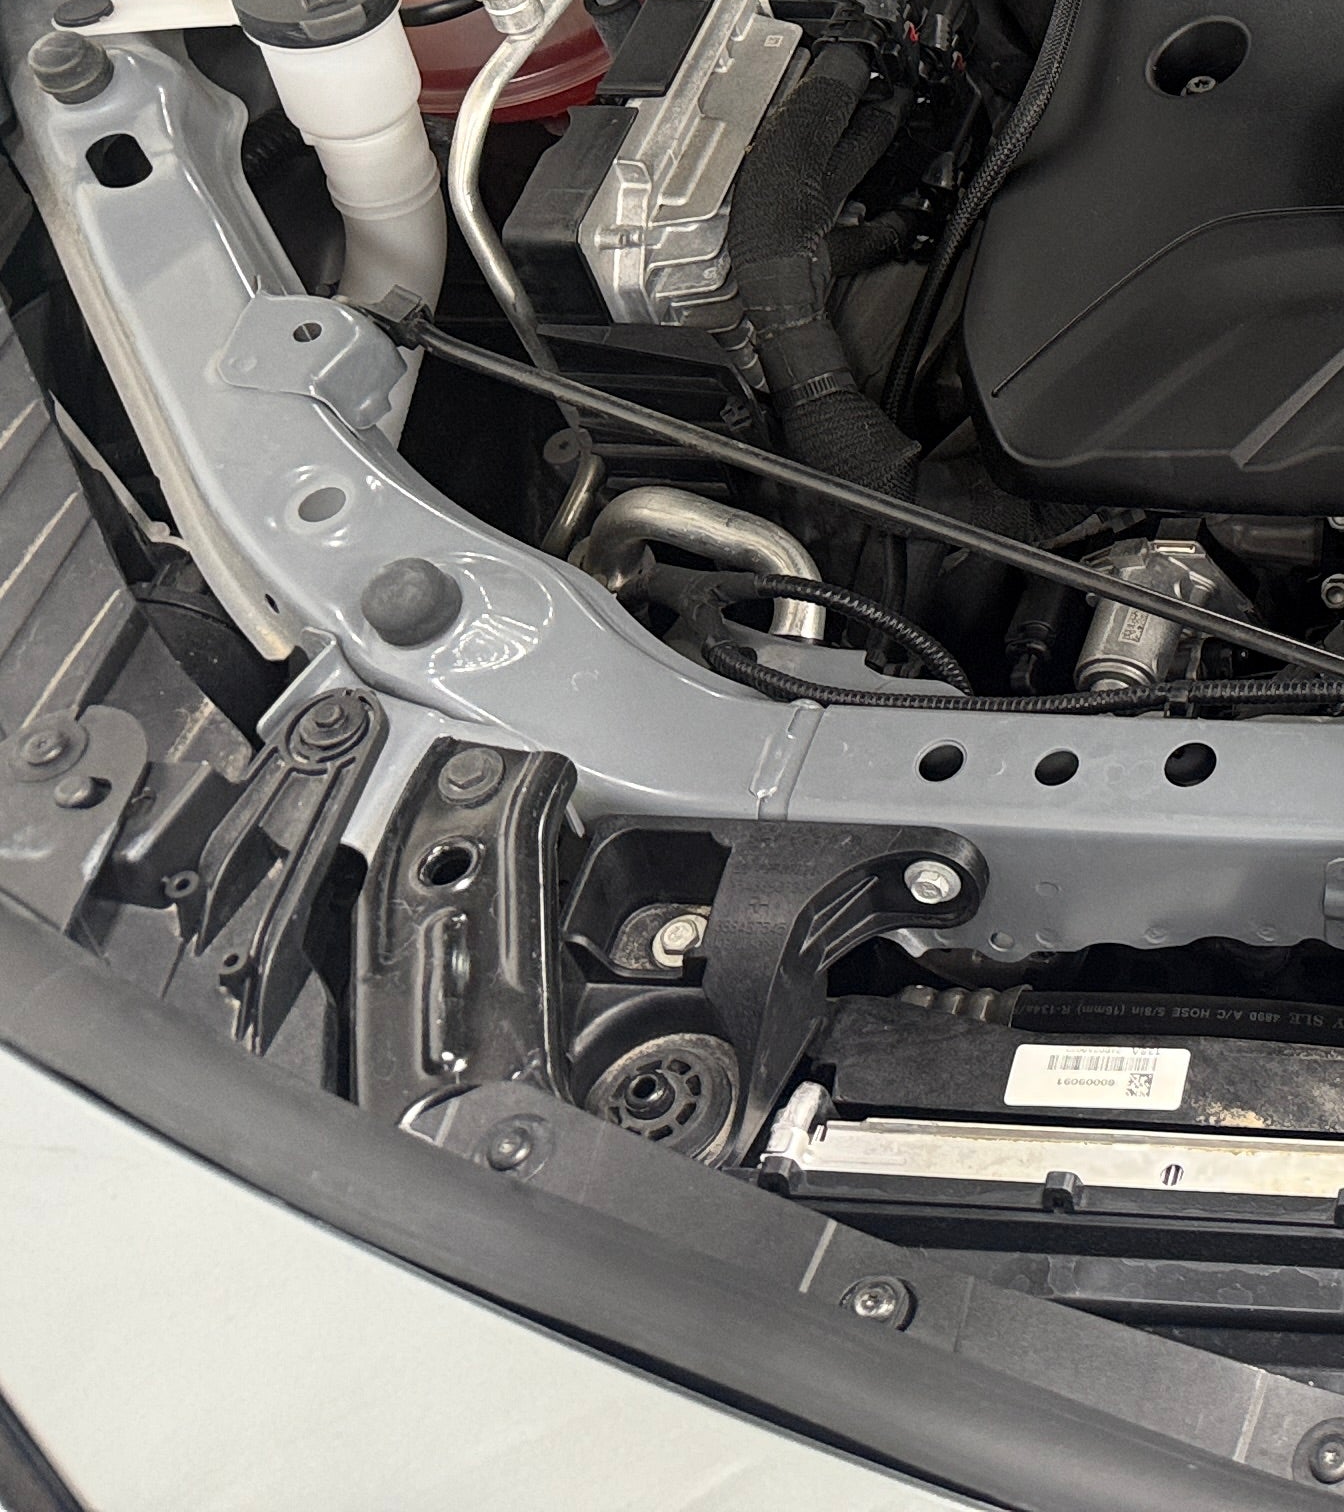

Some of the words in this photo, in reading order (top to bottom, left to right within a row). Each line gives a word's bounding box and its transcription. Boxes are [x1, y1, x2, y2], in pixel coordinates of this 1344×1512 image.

[1077, 1004, 1125, 1016] (16mm)
[1172, 1007, 1210, 1019] HOSE
[1217, 1009, 1243, 1020] A/C
[1290, 1012, 1324, 1027] SLE
